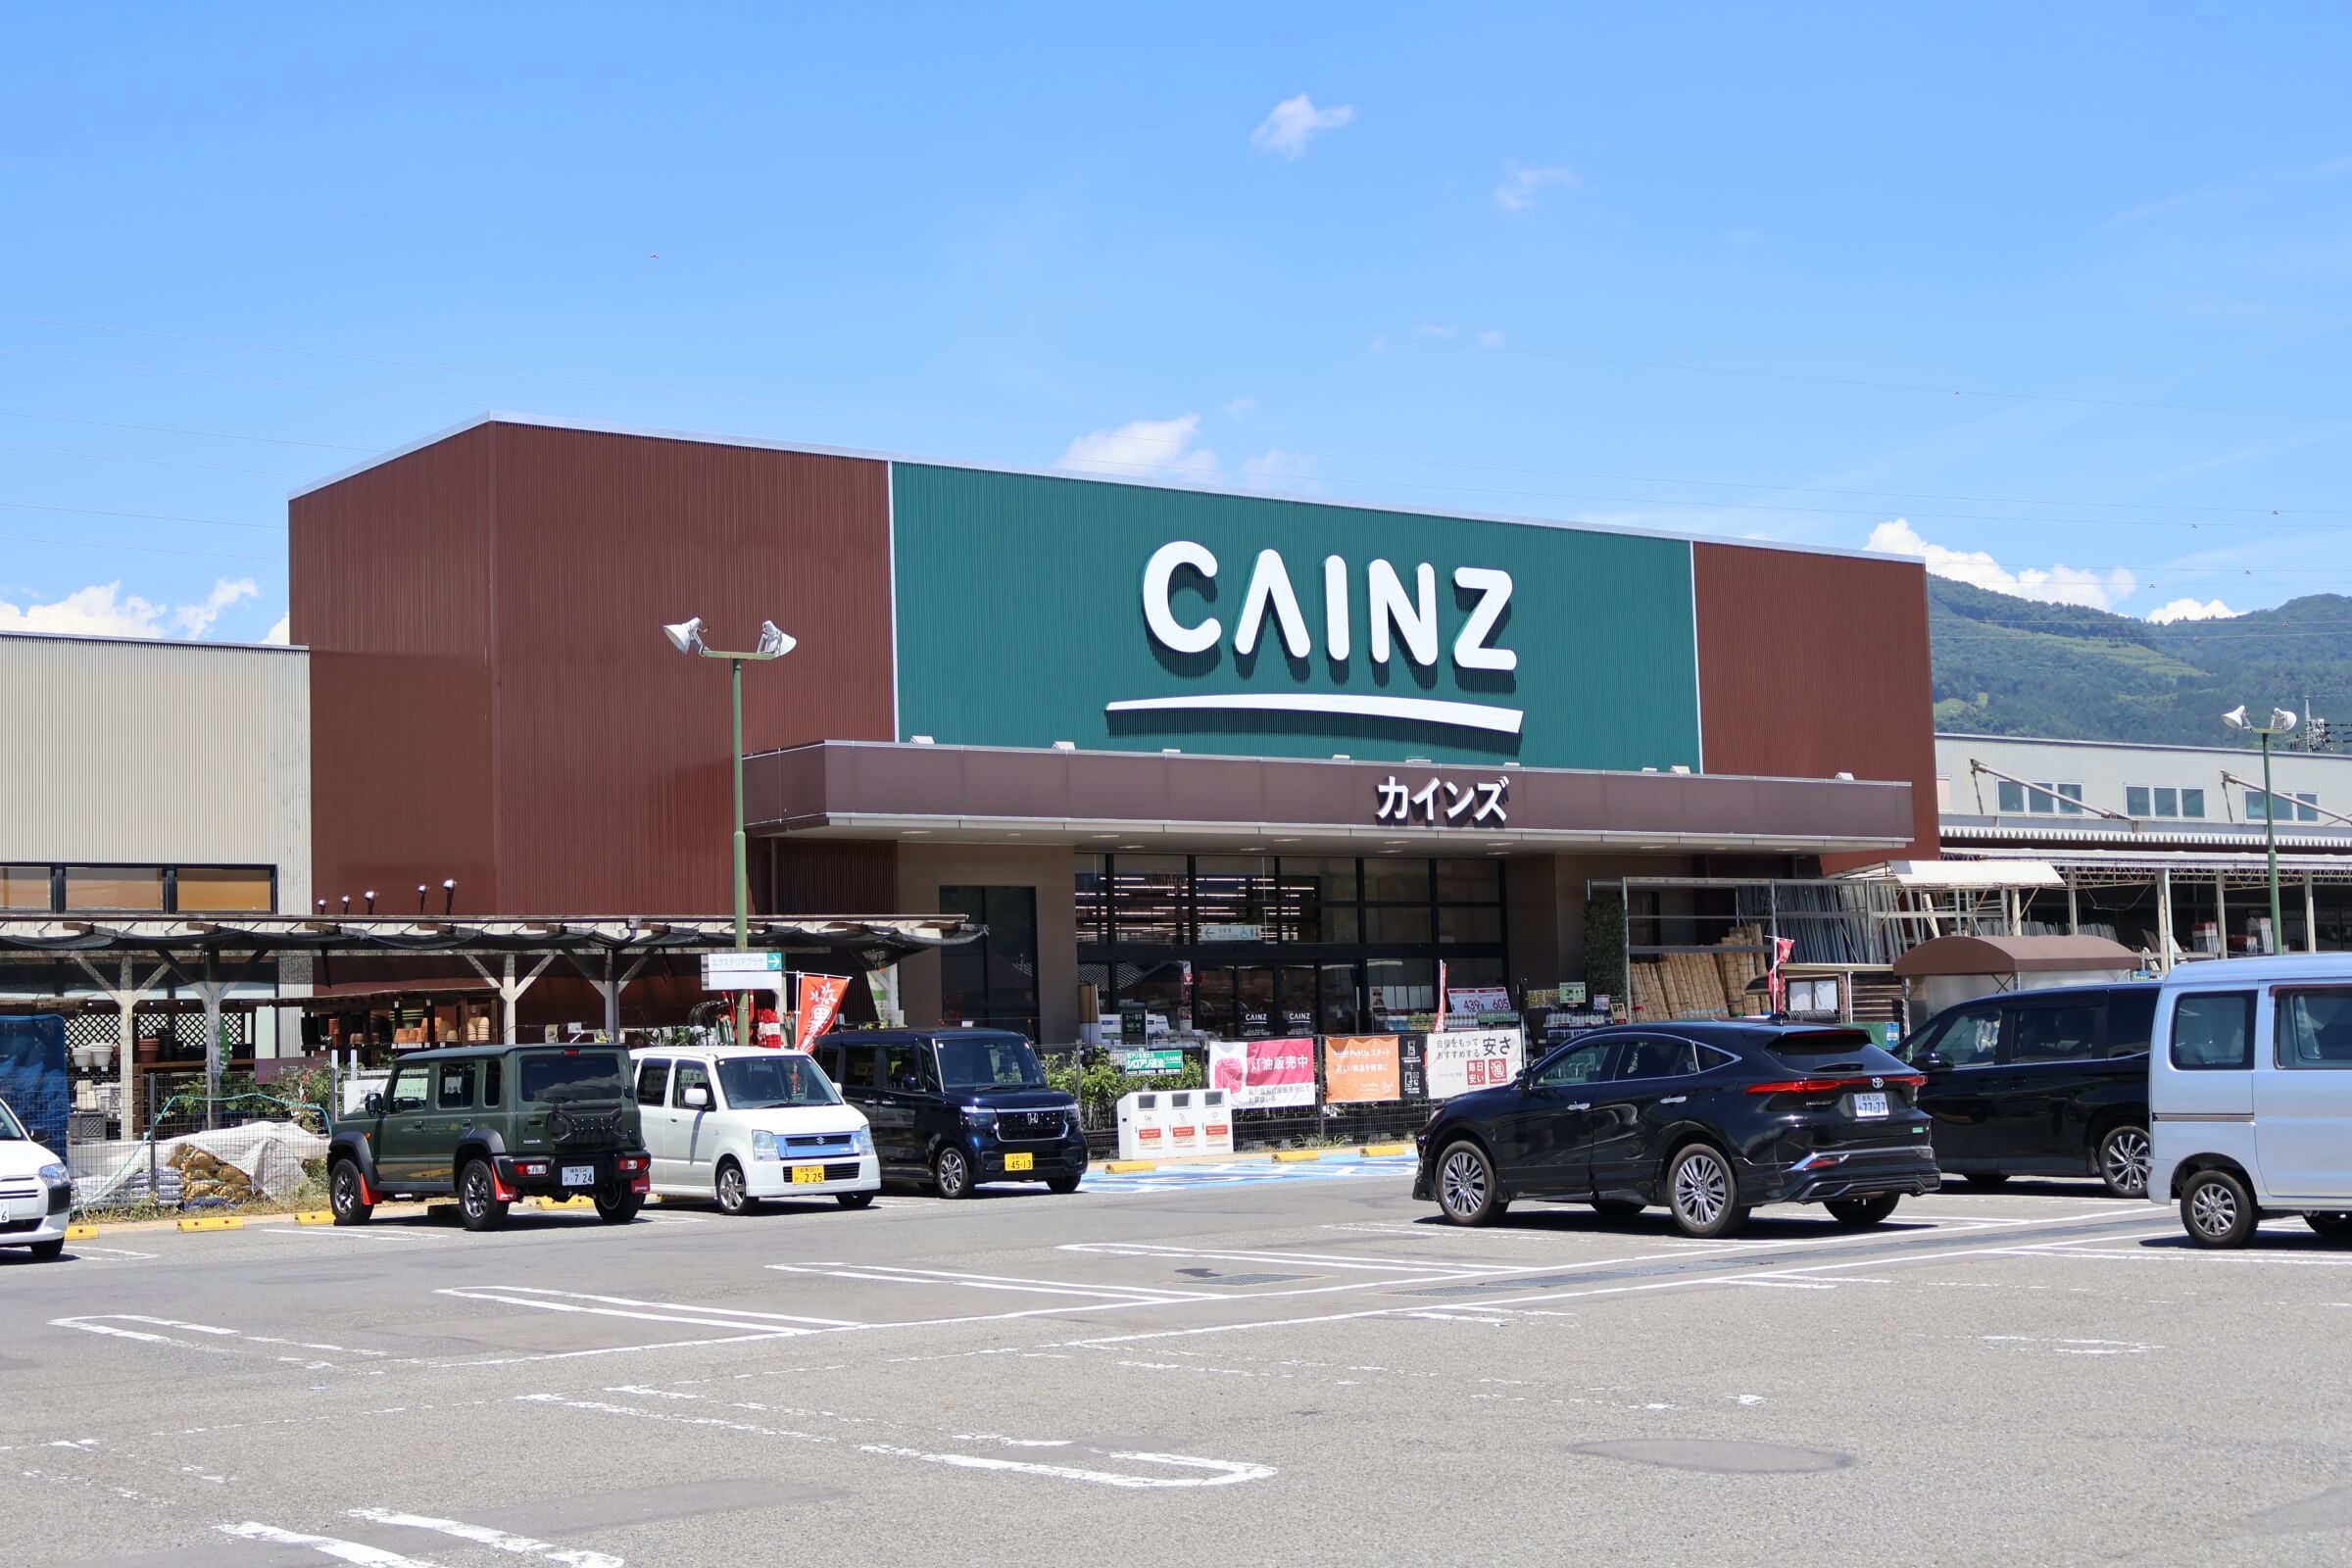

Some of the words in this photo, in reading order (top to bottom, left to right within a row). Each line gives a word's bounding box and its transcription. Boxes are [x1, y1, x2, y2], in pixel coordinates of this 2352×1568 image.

[1142, 540, 1517, 671] CAINZ
[1375, 775, 1509, 822] カインズ
[1464, 1000, 1480, 1010] 439
[1493, 998, 1509, 1009] 605
[1437, 1038, 1479, 1049] 自信をもって
[1483, 1036, 1511, 1056] 安さ
[1437, 1049, 1480, 1059] おすすめする
[1251, 1054, 1308, 1072] 灯油販売中
[1468, 1061, 1484, 1072] 毎日
[1469, 1074, 1484, 1084] 安い
[1, 1210, 7, 1221] 6
